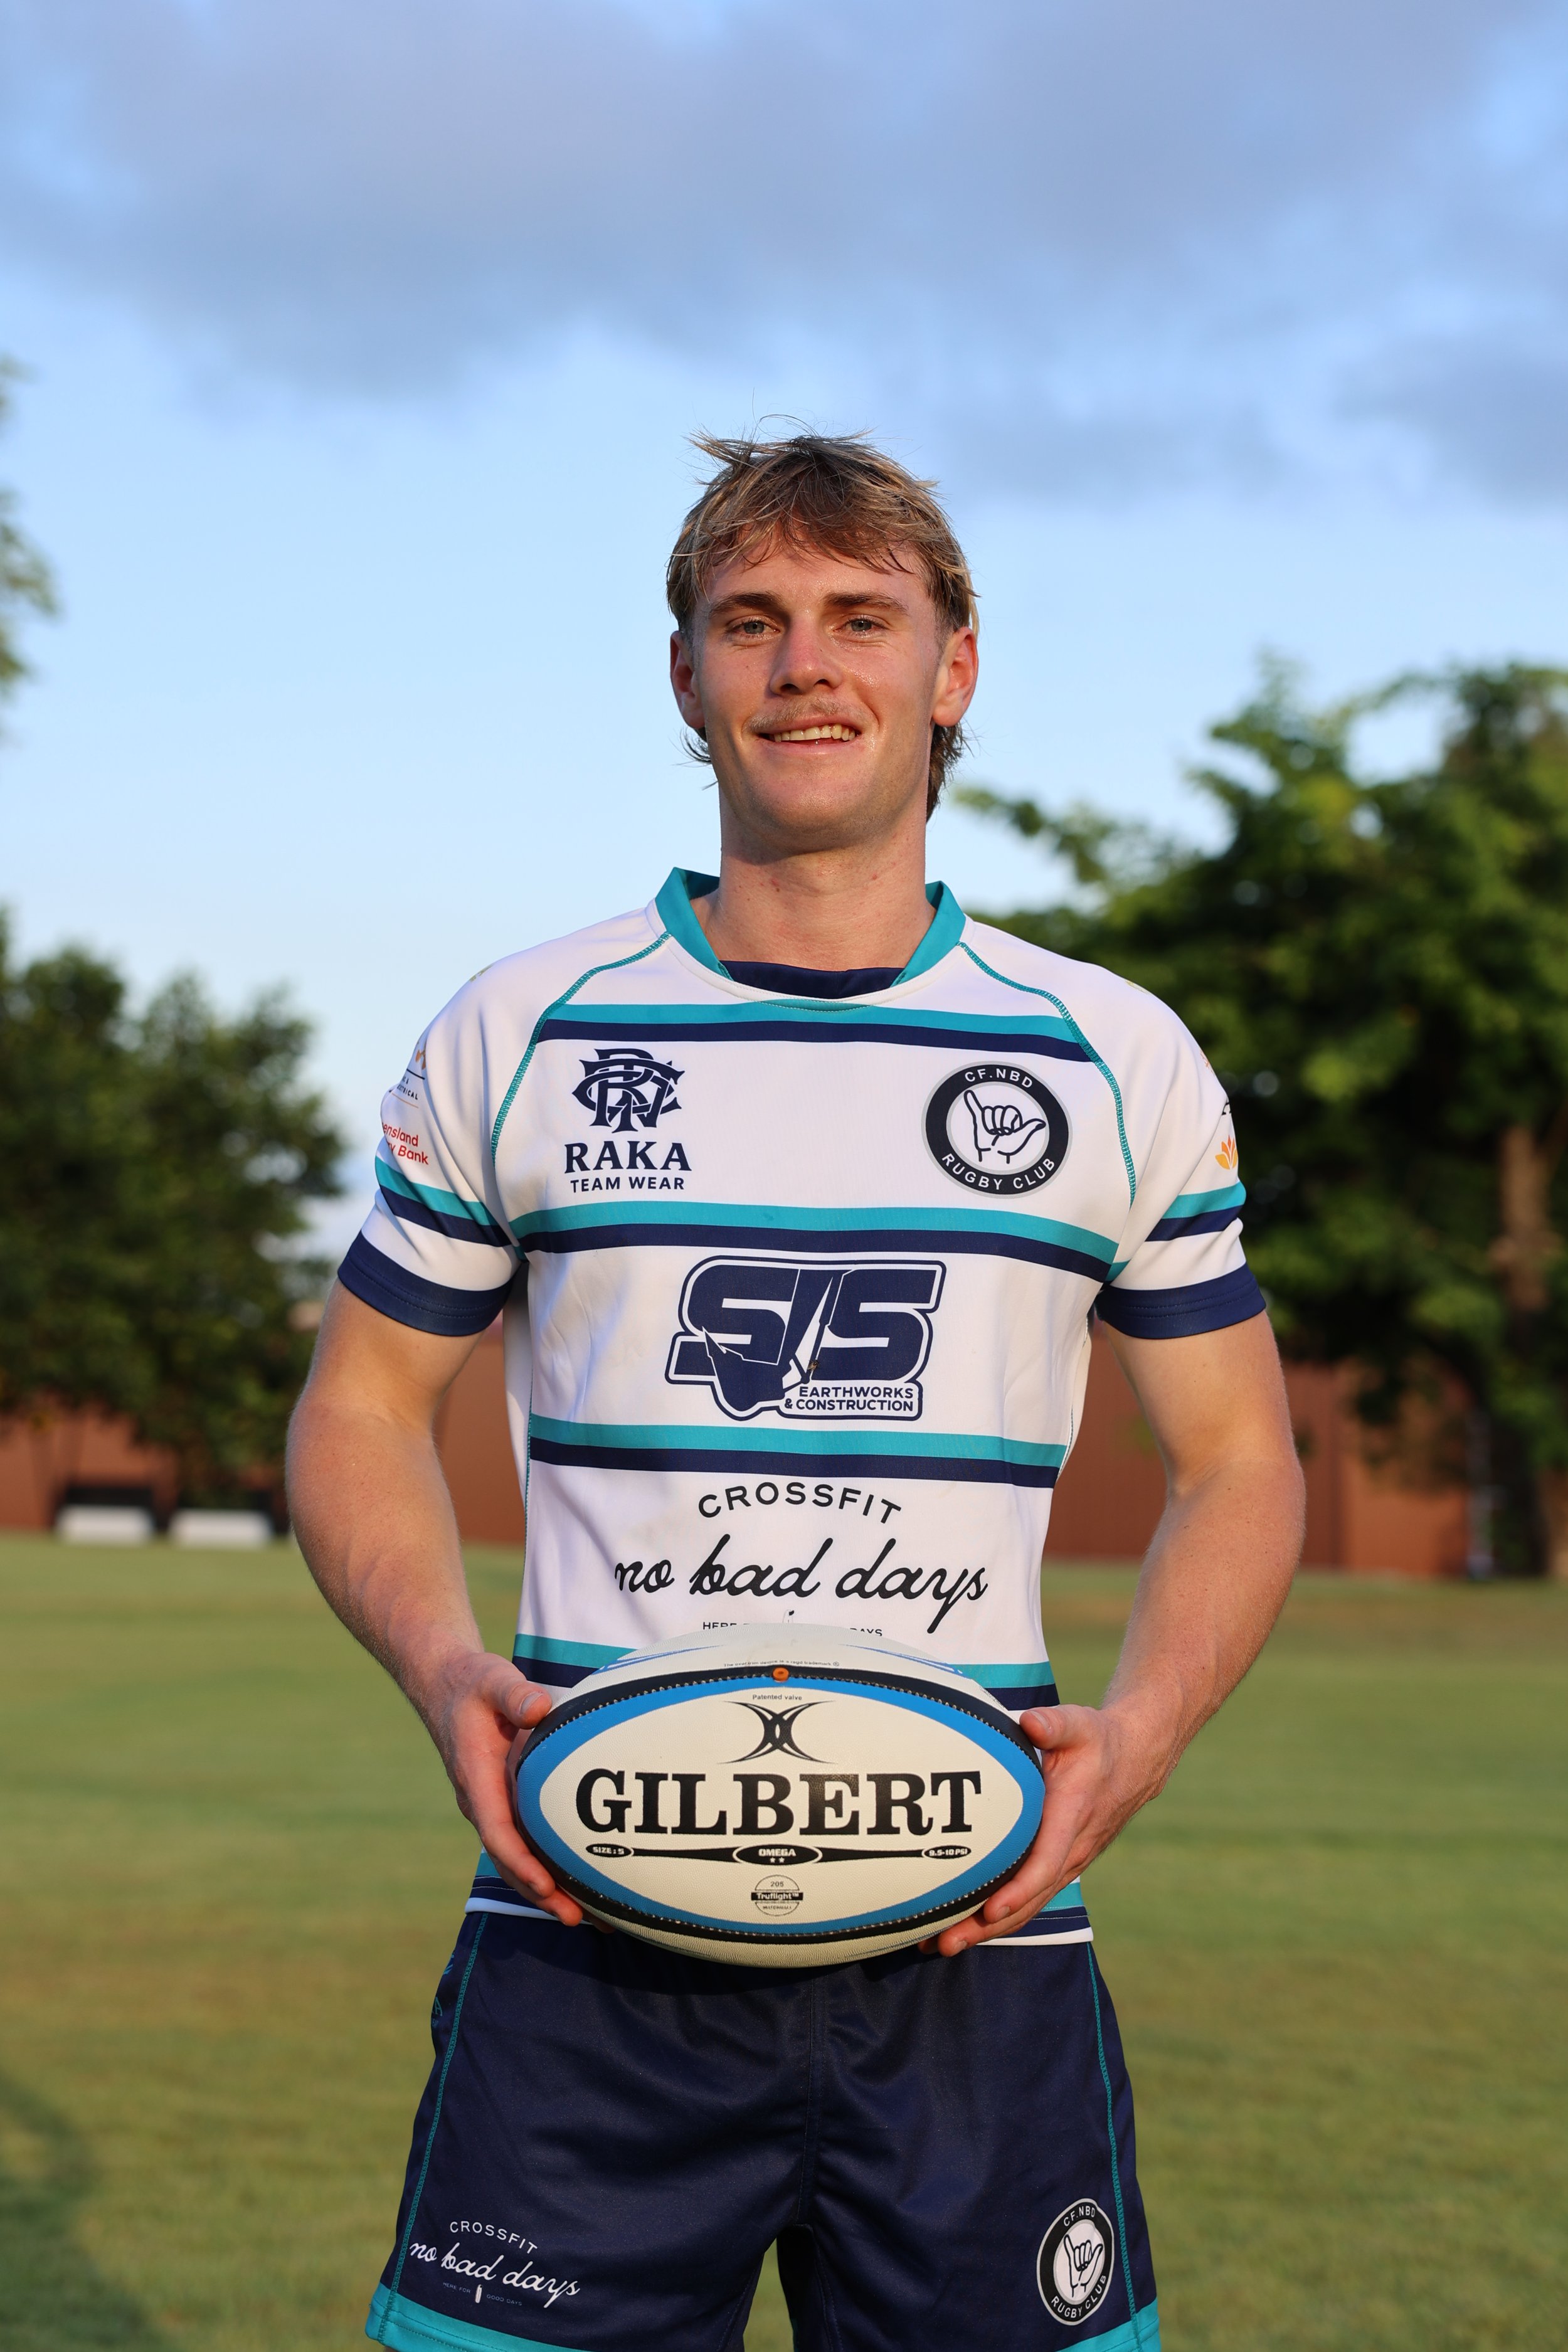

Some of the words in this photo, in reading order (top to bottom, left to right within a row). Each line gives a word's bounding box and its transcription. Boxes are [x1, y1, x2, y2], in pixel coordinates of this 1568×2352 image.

[965, 1068, 1032, 1088] CF.NBD
[382, 1122, 418, 1147] ensland
[398, 1145, 428, 1165] Bank
[564, 1141, 692, 1173] RAKA
[571, 1177, 620, 1192] TEAM
[628, 1177, 684, 1190] WEAR
[942, 1153, 1002, 1190] RUGBY
[1013, 1158, 1054, 1189] CLUB
[784, 1399, 793, 1409] &
[796, 1399, 913, 1411] CONSTRUCTION
[799, 1386, 913, 1399] EARTHWORKS
[698, 1481, 901, 1523] CROSSFIT
[614, 1559, 674, 1594] no
[689, 1534, 834, 1598] bad
[835, 1538, 988, 1634] days
[575, 1769, 982, 1836] GILBERT
[758, 1848, 797, 1857] OMEGA
[1063, 2206, 1096, 2227] CF.NBD
[450, 2220, 538, 2254] CROSSFIT
[410, 2242, 437, 2262] no
[441, 2242, 504, 2280] bad
[502, 2261, 580, 2308] days
[1051, 2296, 1083, 2318] RUGBY
[1085, 2275, 1106, 2309] CLUB
